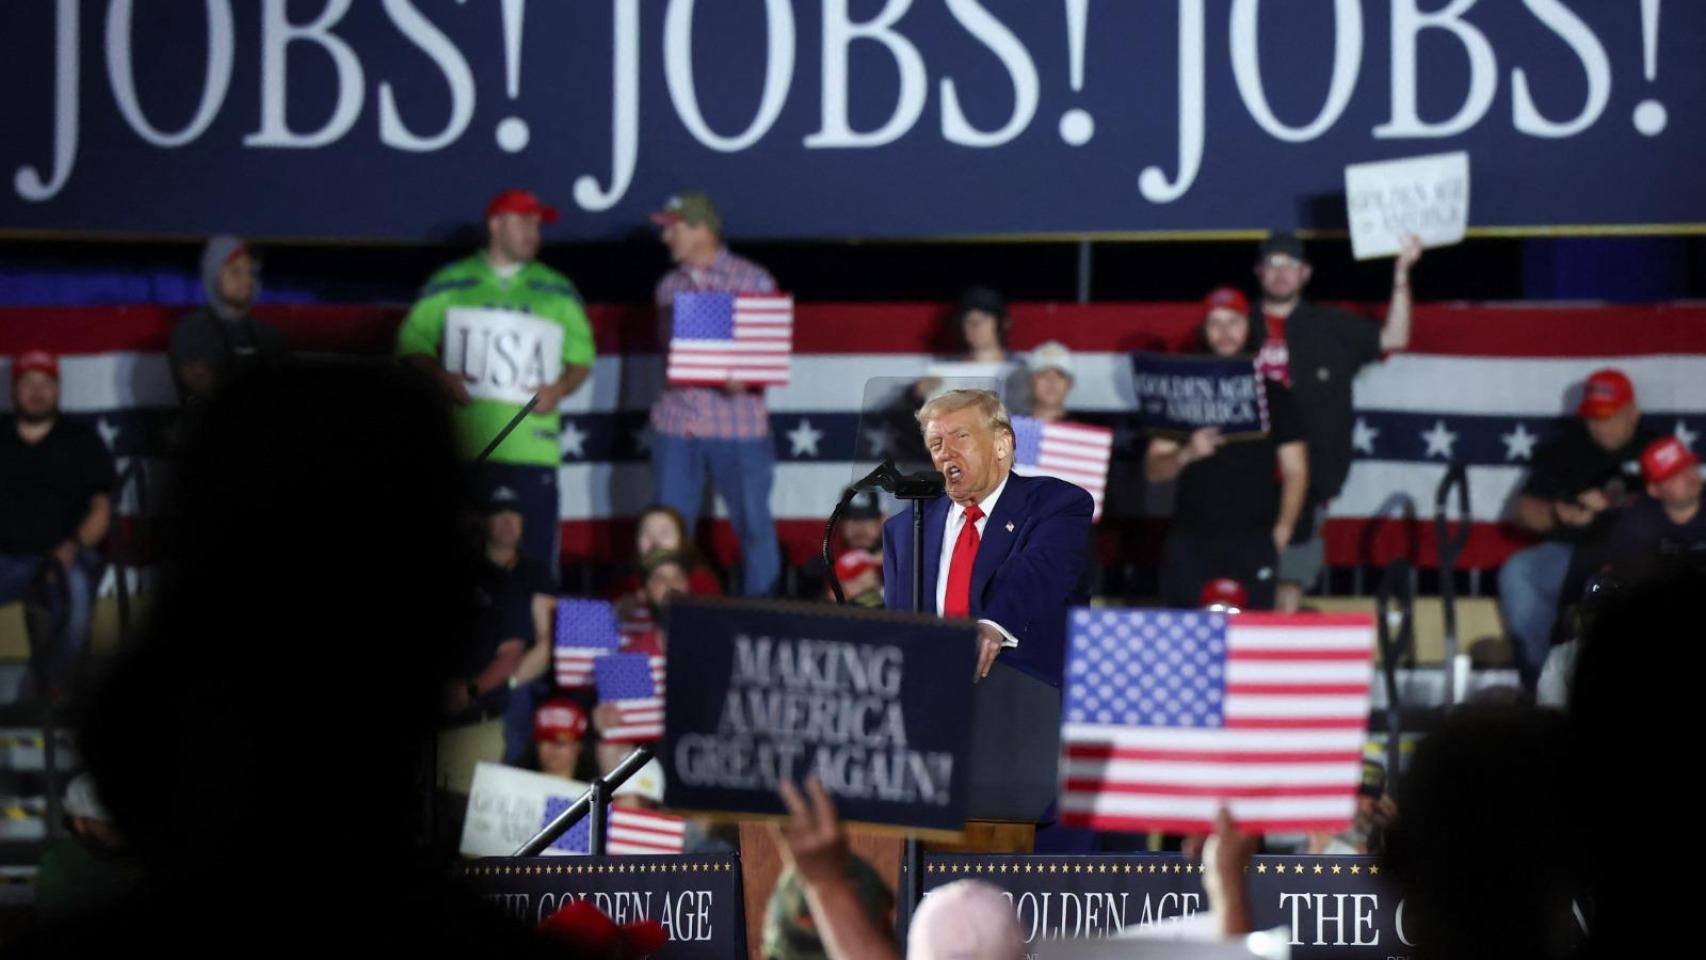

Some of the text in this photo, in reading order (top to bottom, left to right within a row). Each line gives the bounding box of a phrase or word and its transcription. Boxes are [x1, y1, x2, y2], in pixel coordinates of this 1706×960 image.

[14, 0, 1667, 211] JOBS! JOBS! JOBS!
[459, 326, 547, 391] USA
[1136, 373, 1257, 401] GOLDEN AGE
[1166, 400, 1256, 425] AMERICA
[732, 634, 904, 698] MAKING
[716, 688, 908, 748] AMERICA
[674, 732, 954, 806] GREAT AGAIN!
[537, 891, 653, 927] GDEN
[660, 890, 712, 942] AGE
[1001, 891, 1129, 943] OLDEN
[1279, 892, 1379, 946] THE
